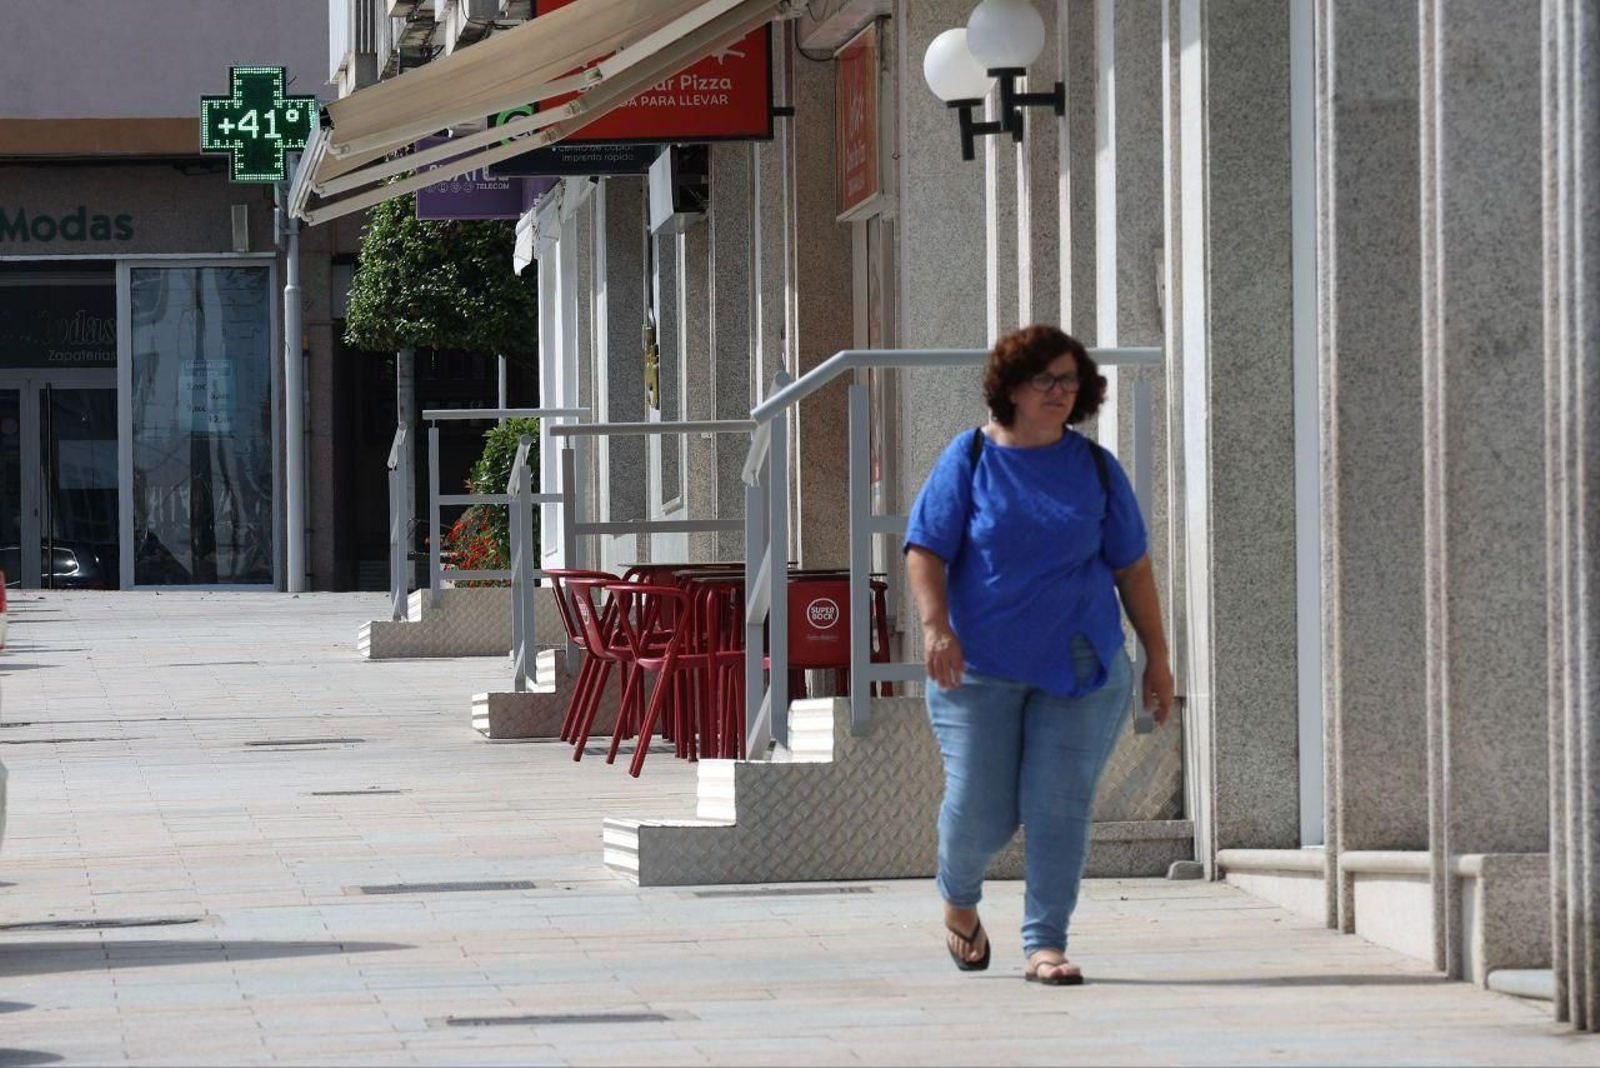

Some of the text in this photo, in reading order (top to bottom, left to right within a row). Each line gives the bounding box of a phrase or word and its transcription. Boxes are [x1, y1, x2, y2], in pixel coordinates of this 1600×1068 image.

[651, 74, 731, 91] ar Pizza
[641, 95, 676, 106] PARA
[680, 94, 728, 106] LLEVAR
[562, 152, 602, 162] imprenta
[0, 205, 134, 242] Modas
[810, 606, 835, 614] SUPER
[811, 613, 834, 621] BOCK
